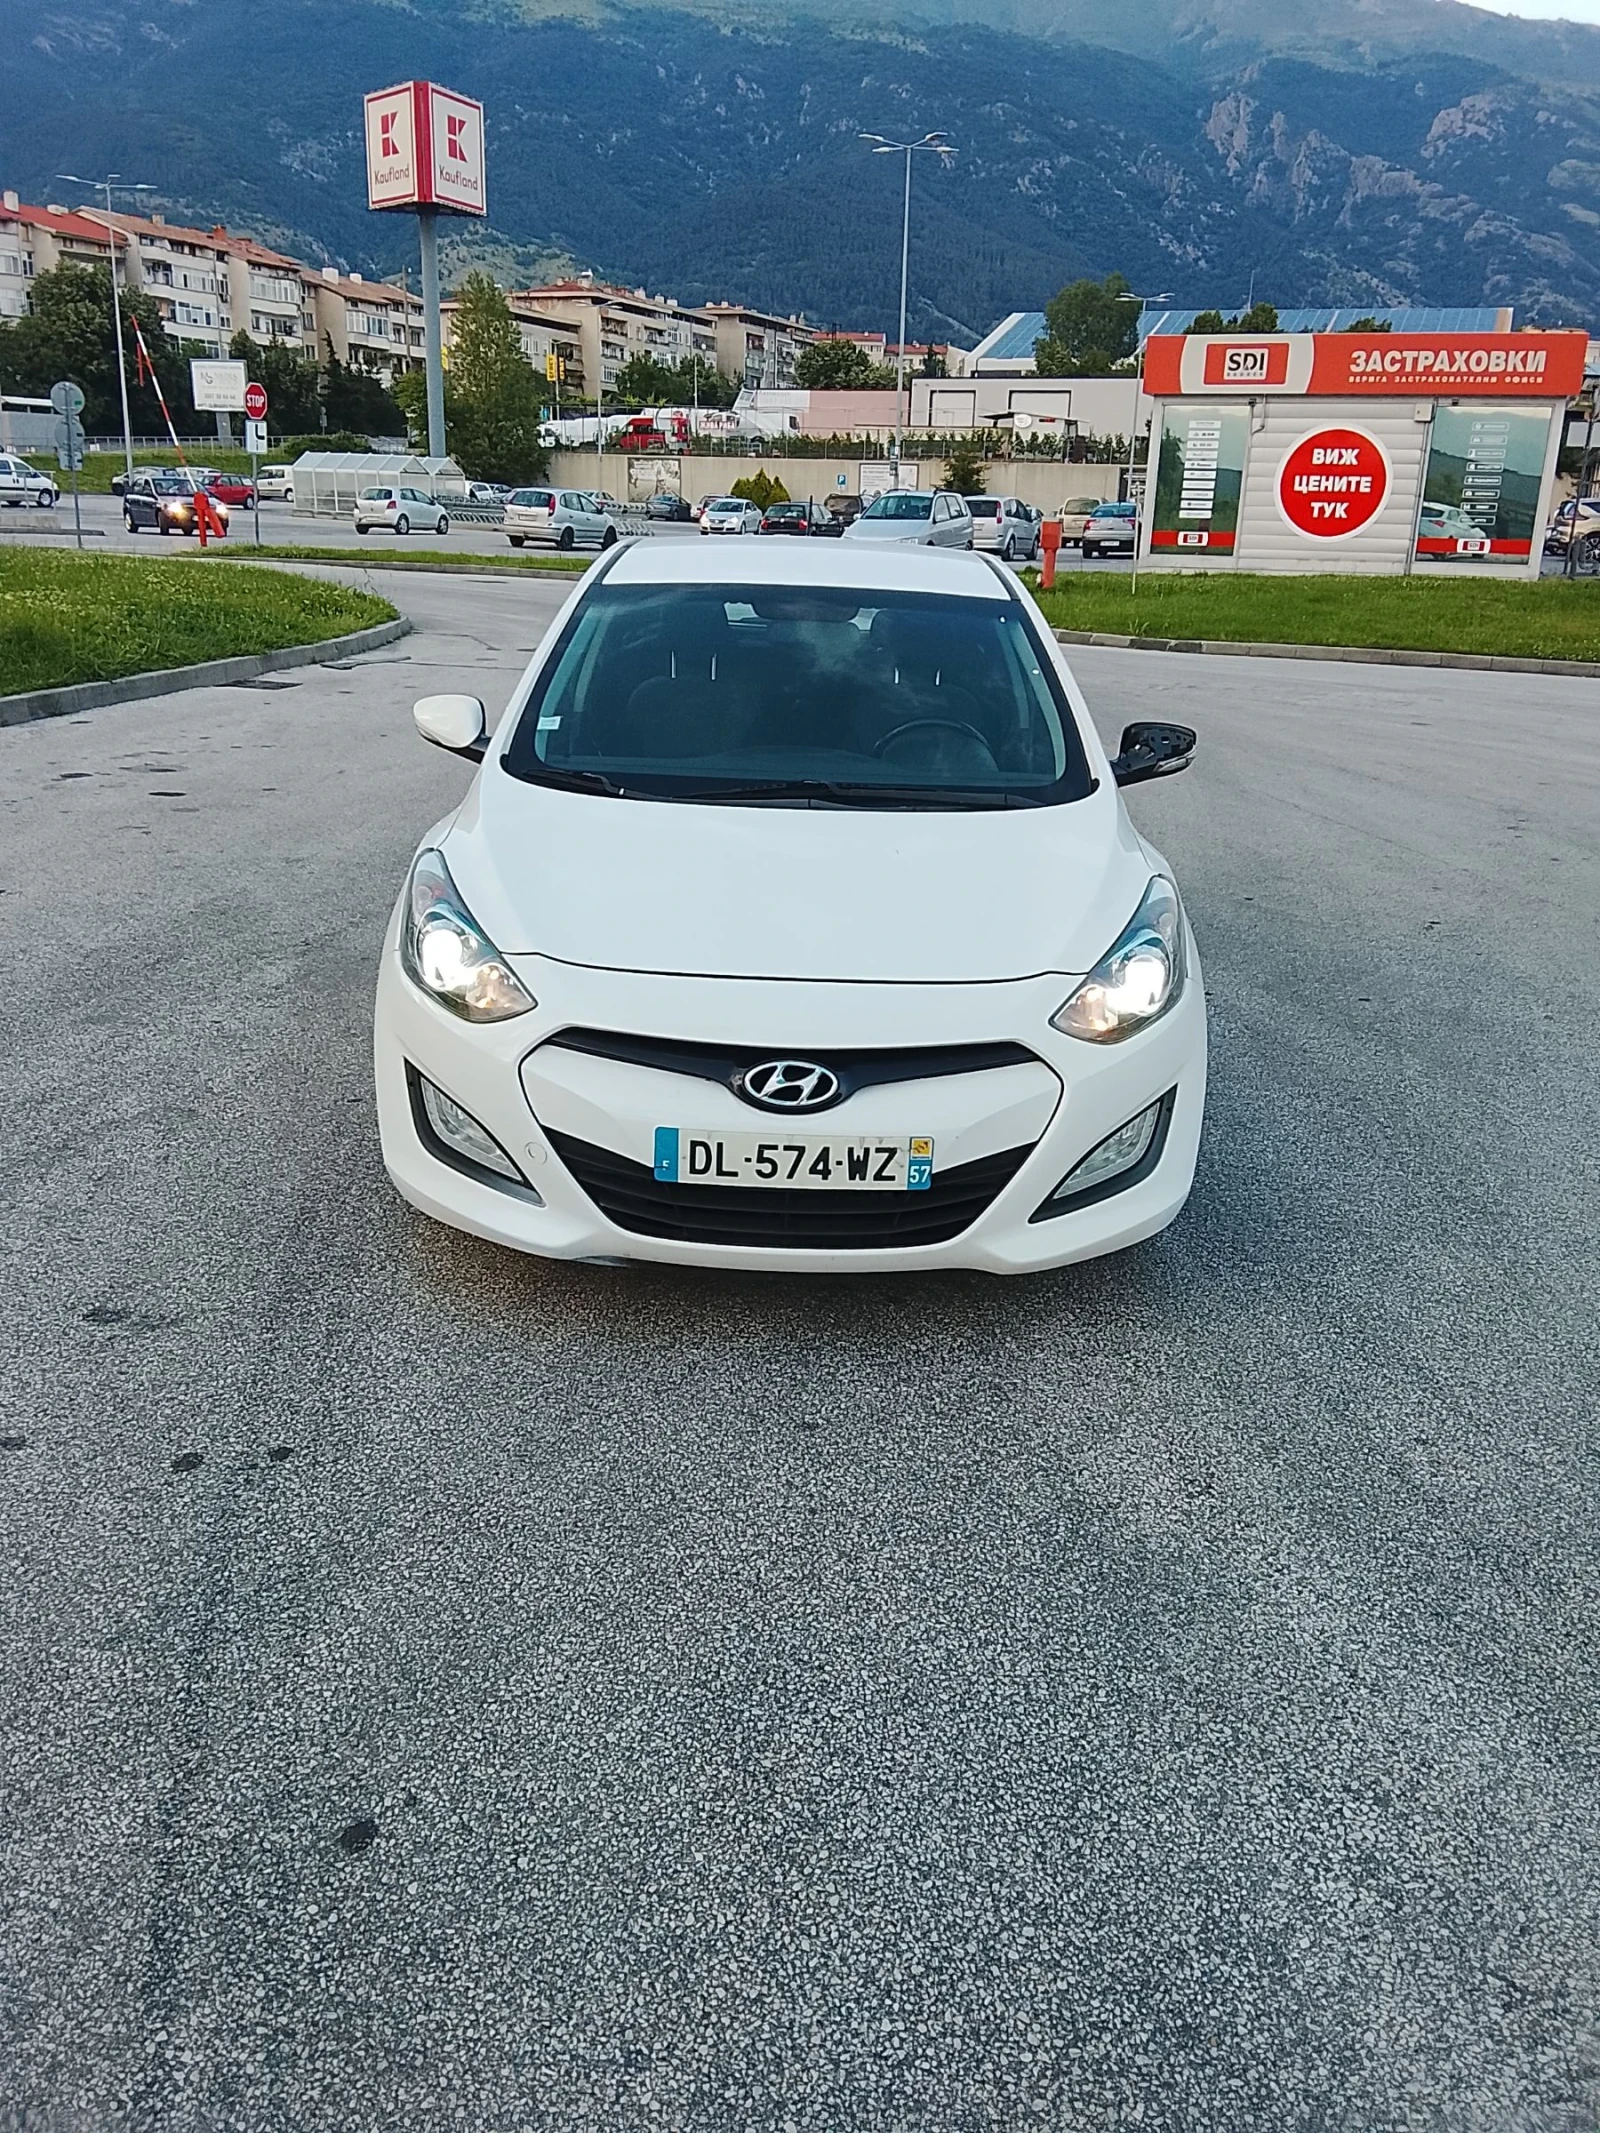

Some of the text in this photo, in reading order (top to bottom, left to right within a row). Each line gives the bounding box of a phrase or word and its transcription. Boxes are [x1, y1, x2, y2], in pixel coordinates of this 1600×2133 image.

[374, 163, 410, 186] Kaufland
[439, 164, 479, 191] Kaufland
[1228, 353, 1265, 371] SDI
[1349, 350, 1547, 373] ЗАСТРАХОВКИ
[1504, 376, 1544, 384] ОФИСИ
[247, 394, 265, 408] STOP
[1312, 448, 1360, 465] ВИЖ
[1293, 475, 1372, 494] ЦЕНИТЕ
[1310, 502, 1349, 518] ТУК
[689, 1140, 897, 1182] DL-574-WZ
[909, 1165, 931, 1184] 57
